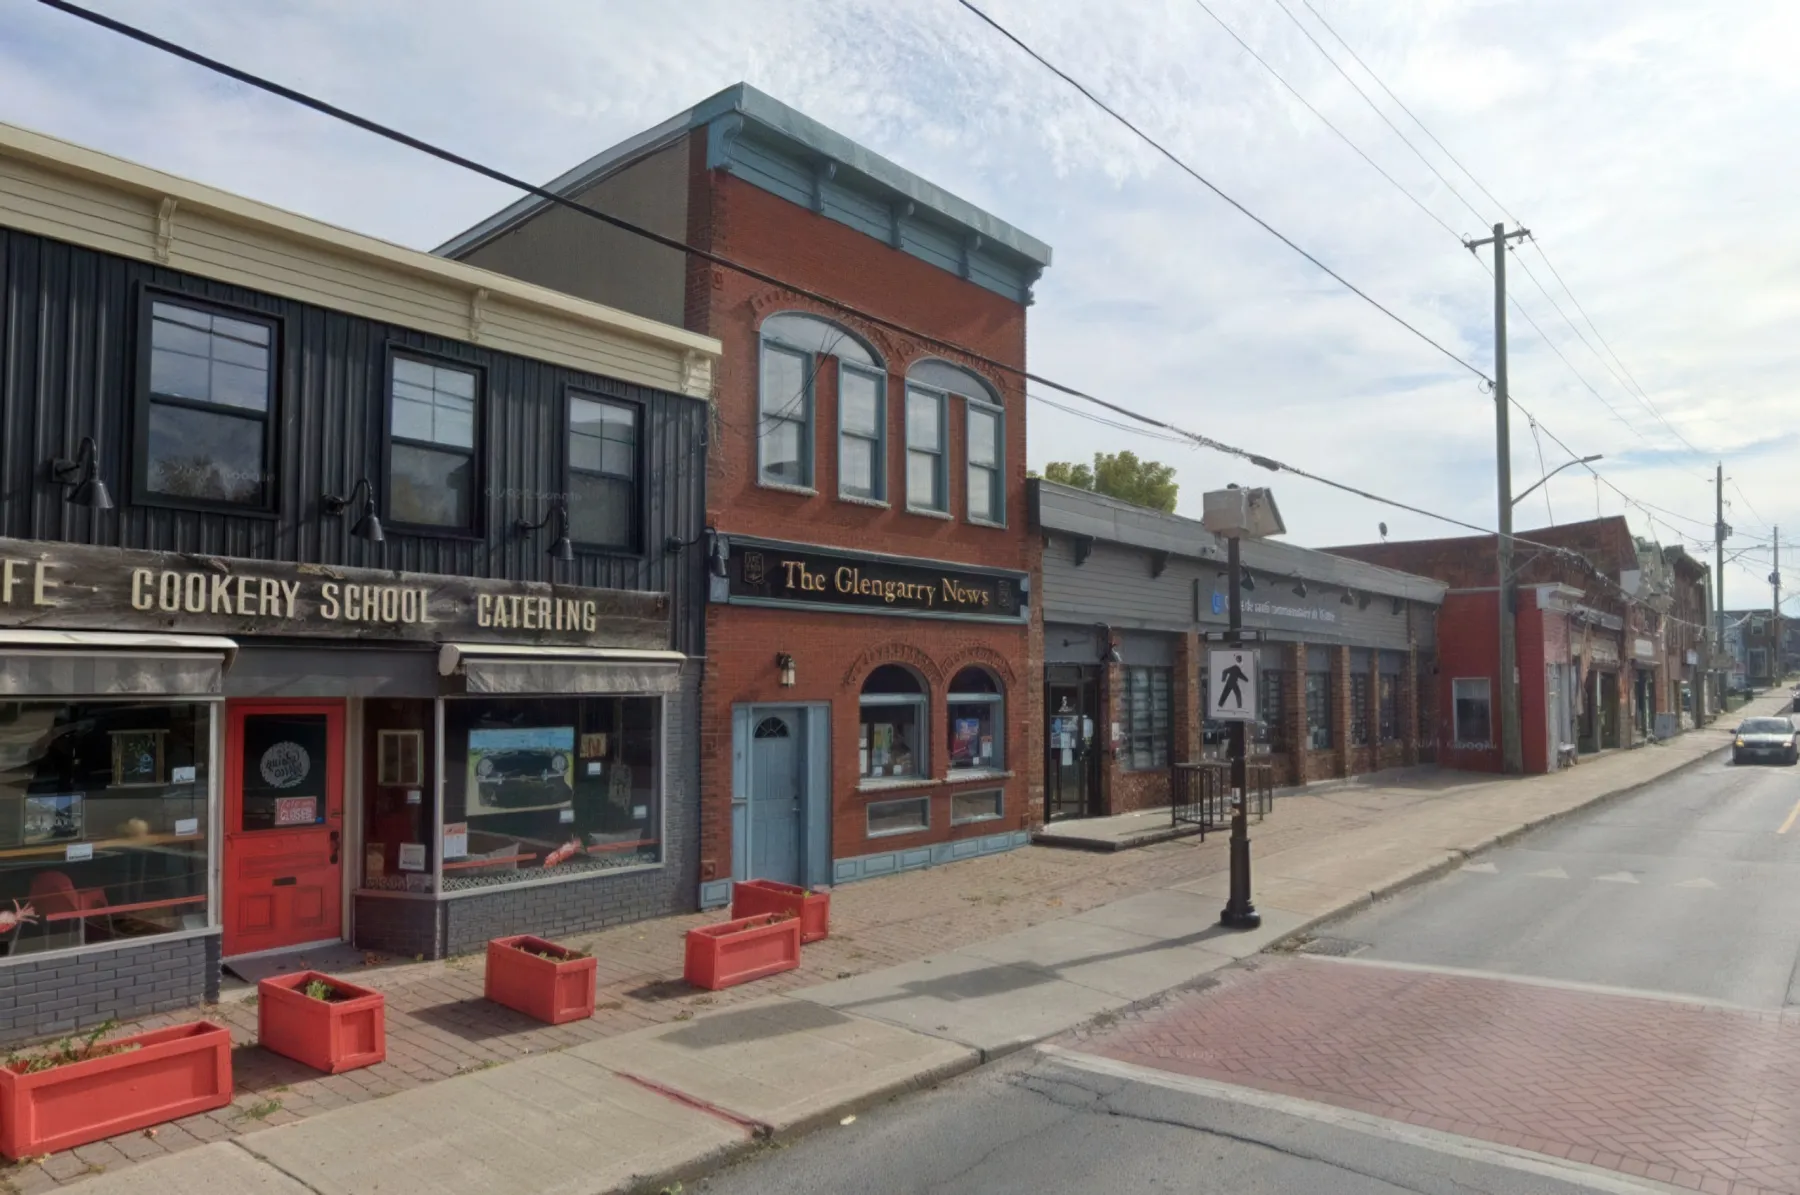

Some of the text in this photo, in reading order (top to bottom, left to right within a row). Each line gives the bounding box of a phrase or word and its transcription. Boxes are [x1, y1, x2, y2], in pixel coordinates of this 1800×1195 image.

[131, 568, 300, 618] COOKERY
[320, 582, 434, 624] SCHOOL
[476, 592, 597, 632] CATERING
[781, 561, 826, 591] The
[834, 566, 936, 606] Glengarry
[941, 577, 990, 606] News
